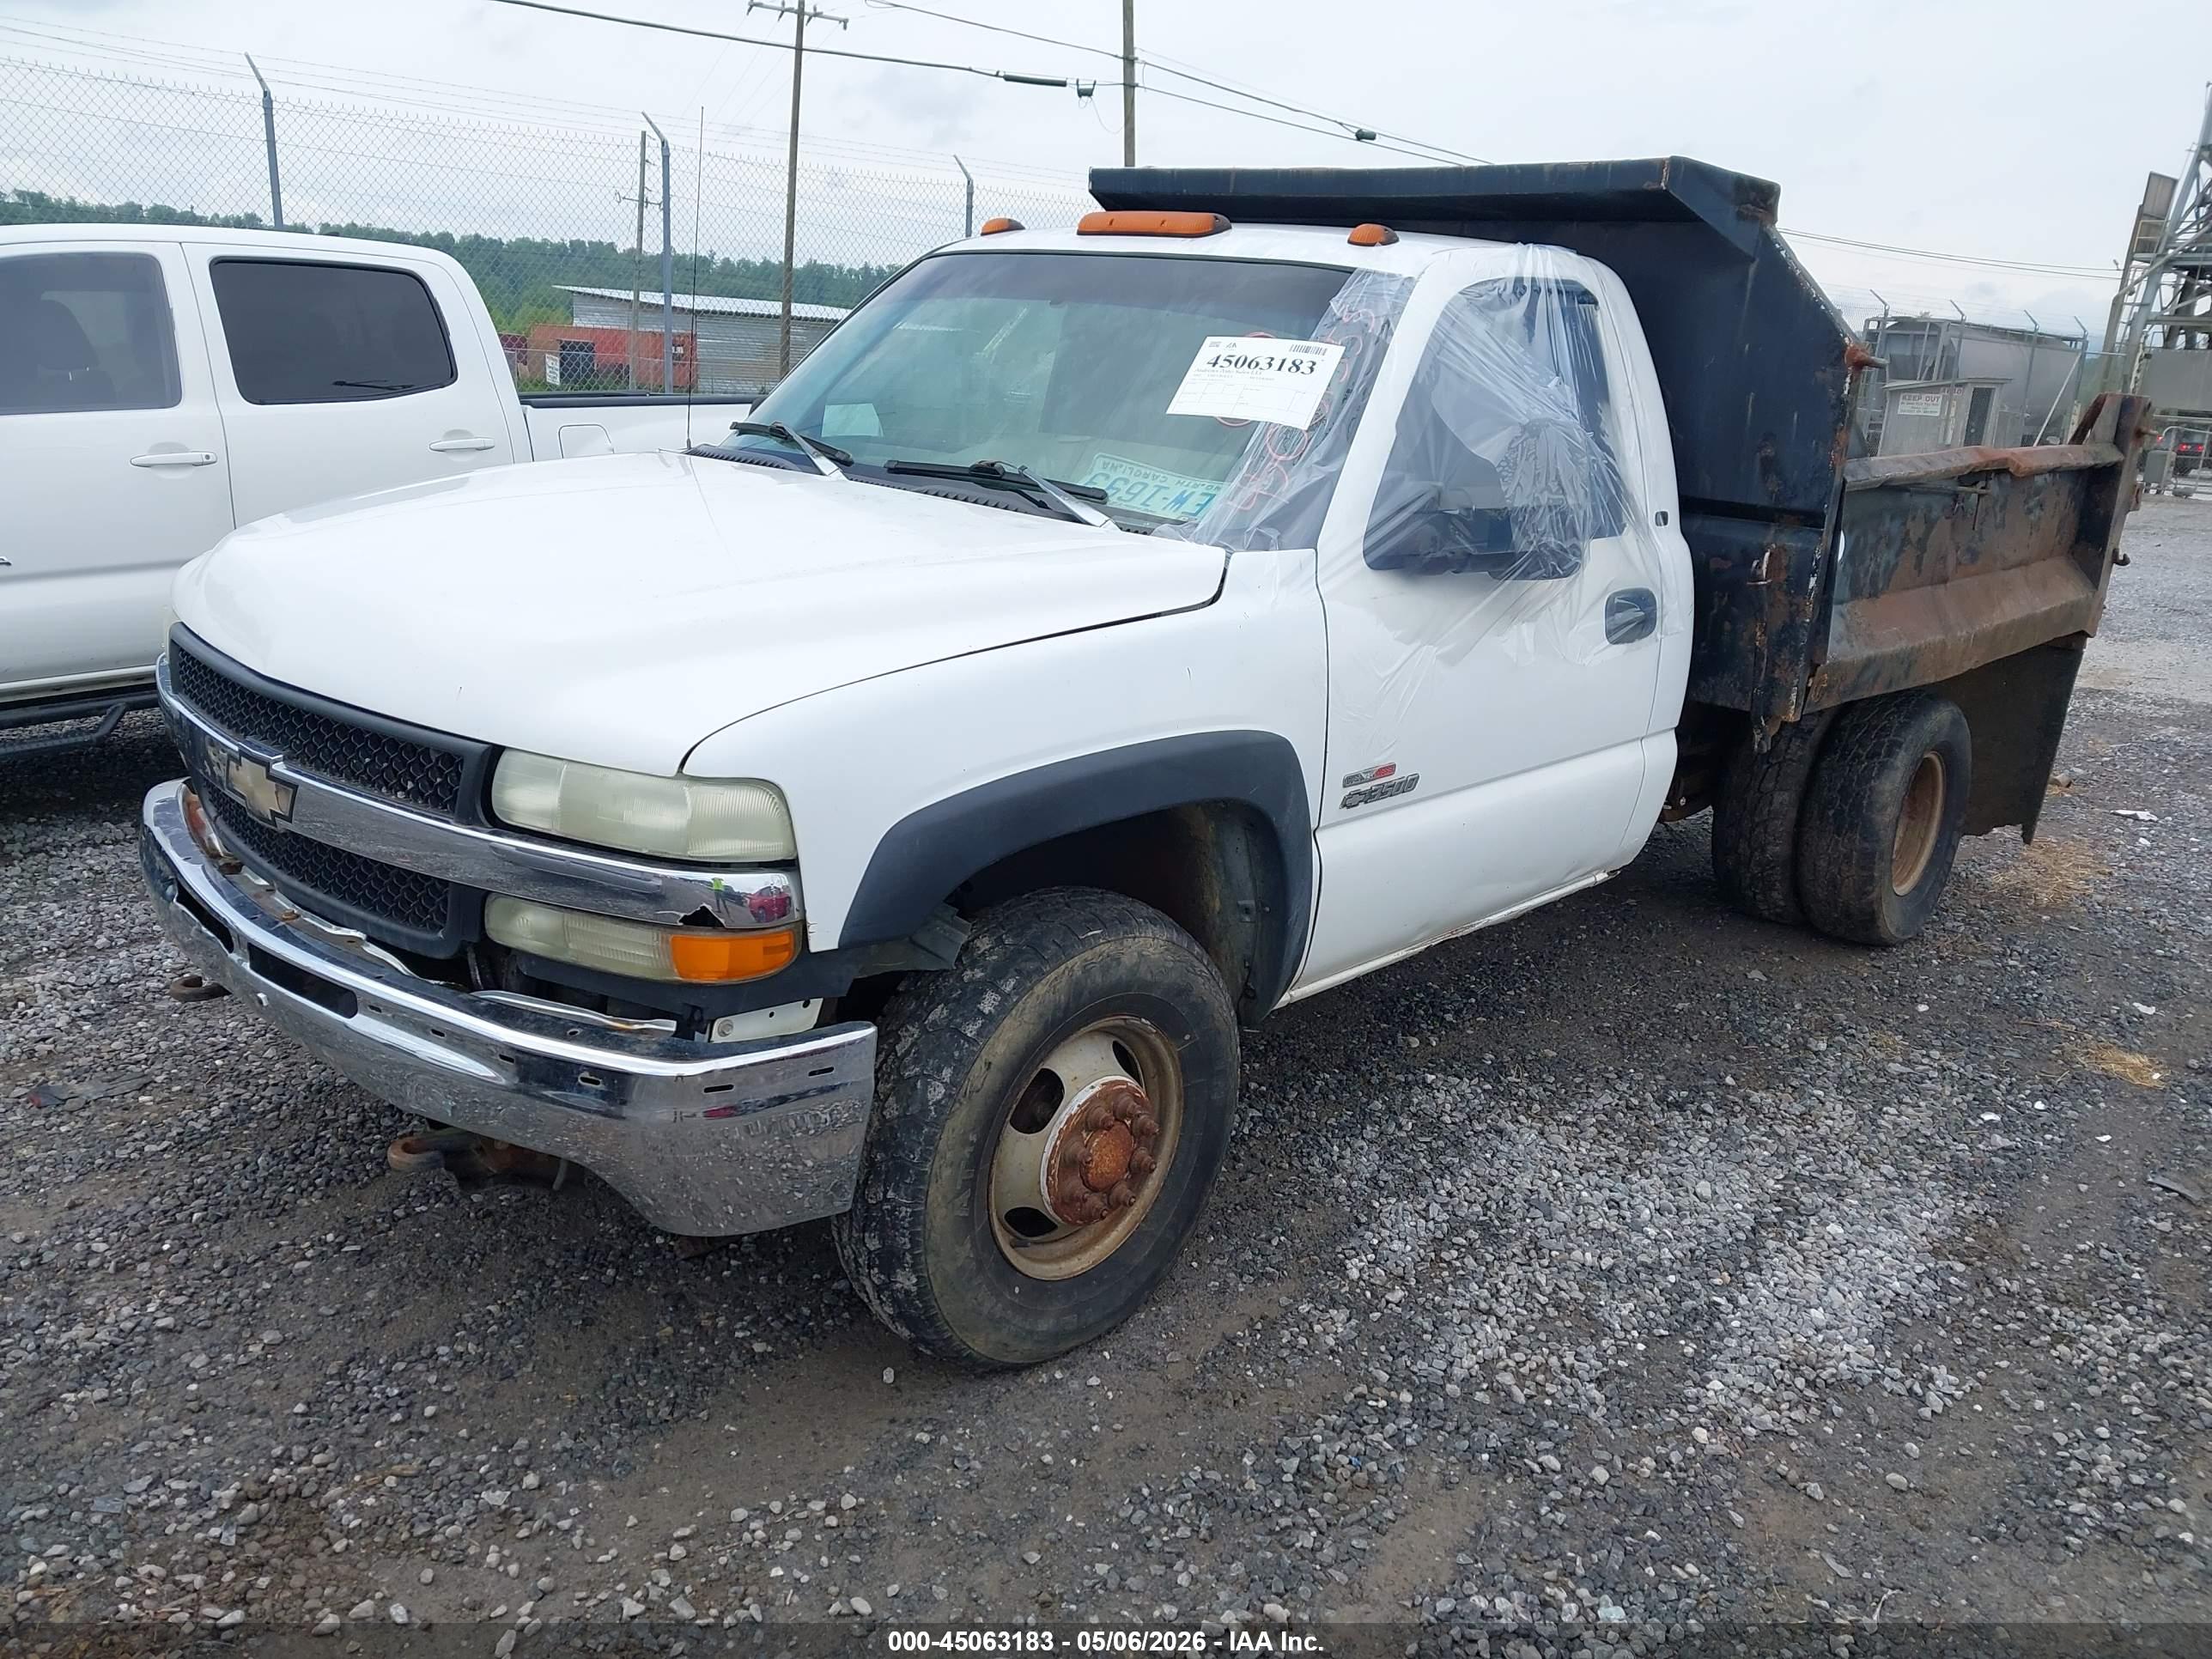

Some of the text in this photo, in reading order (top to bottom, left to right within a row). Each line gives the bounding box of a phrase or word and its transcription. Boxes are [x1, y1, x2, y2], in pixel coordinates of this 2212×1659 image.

[1206, 353, 1317, 375] 45063183
[1102, 459, 1169, 483] CAROLINA
[1365, 773, 1420, 804] 3500
